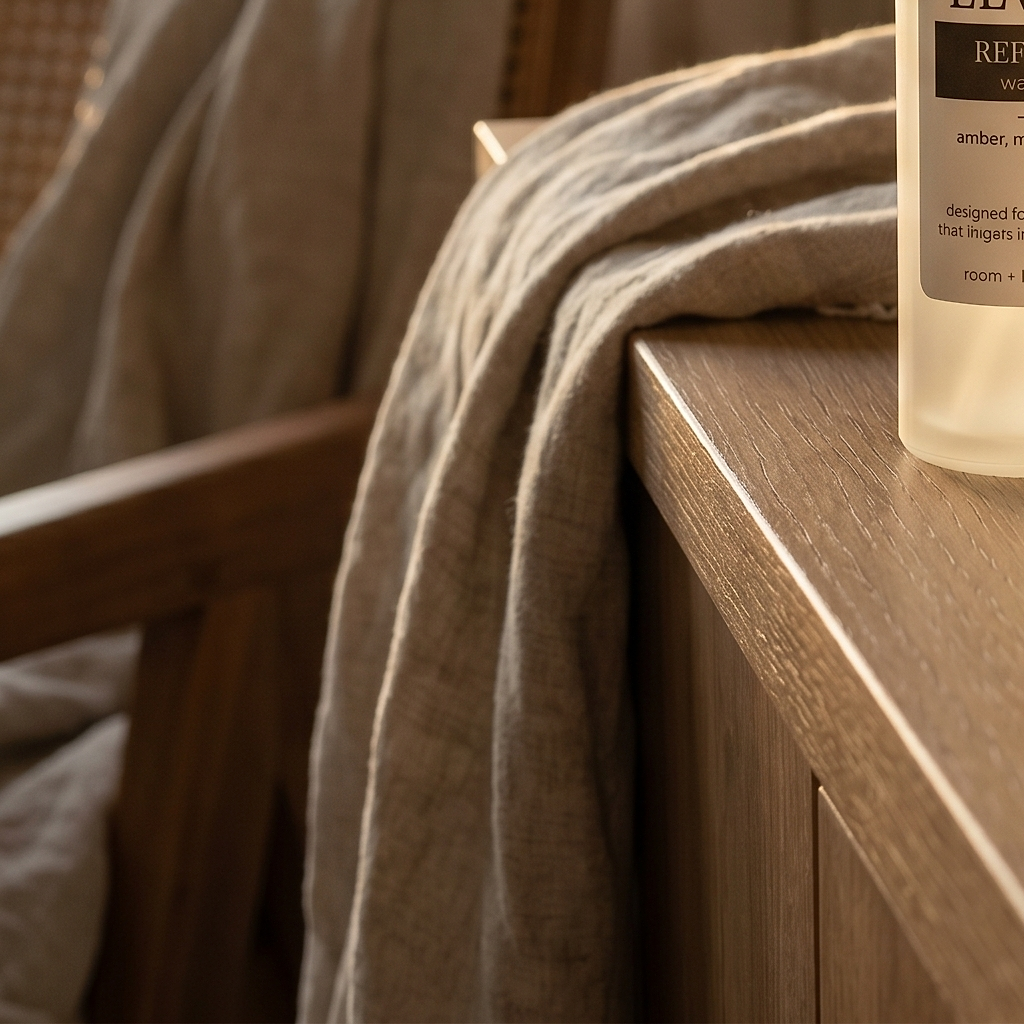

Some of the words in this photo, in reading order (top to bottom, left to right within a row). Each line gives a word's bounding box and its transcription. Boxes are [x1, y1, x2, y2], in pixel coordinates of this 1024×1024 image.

[956, 130, 1009, 148] amber,
[946, 203, 1008, 223] designed
[937, 222, 964, 238] that
[964, 270, 1002, 283] room
[1007, 272, 1016, 281] +
